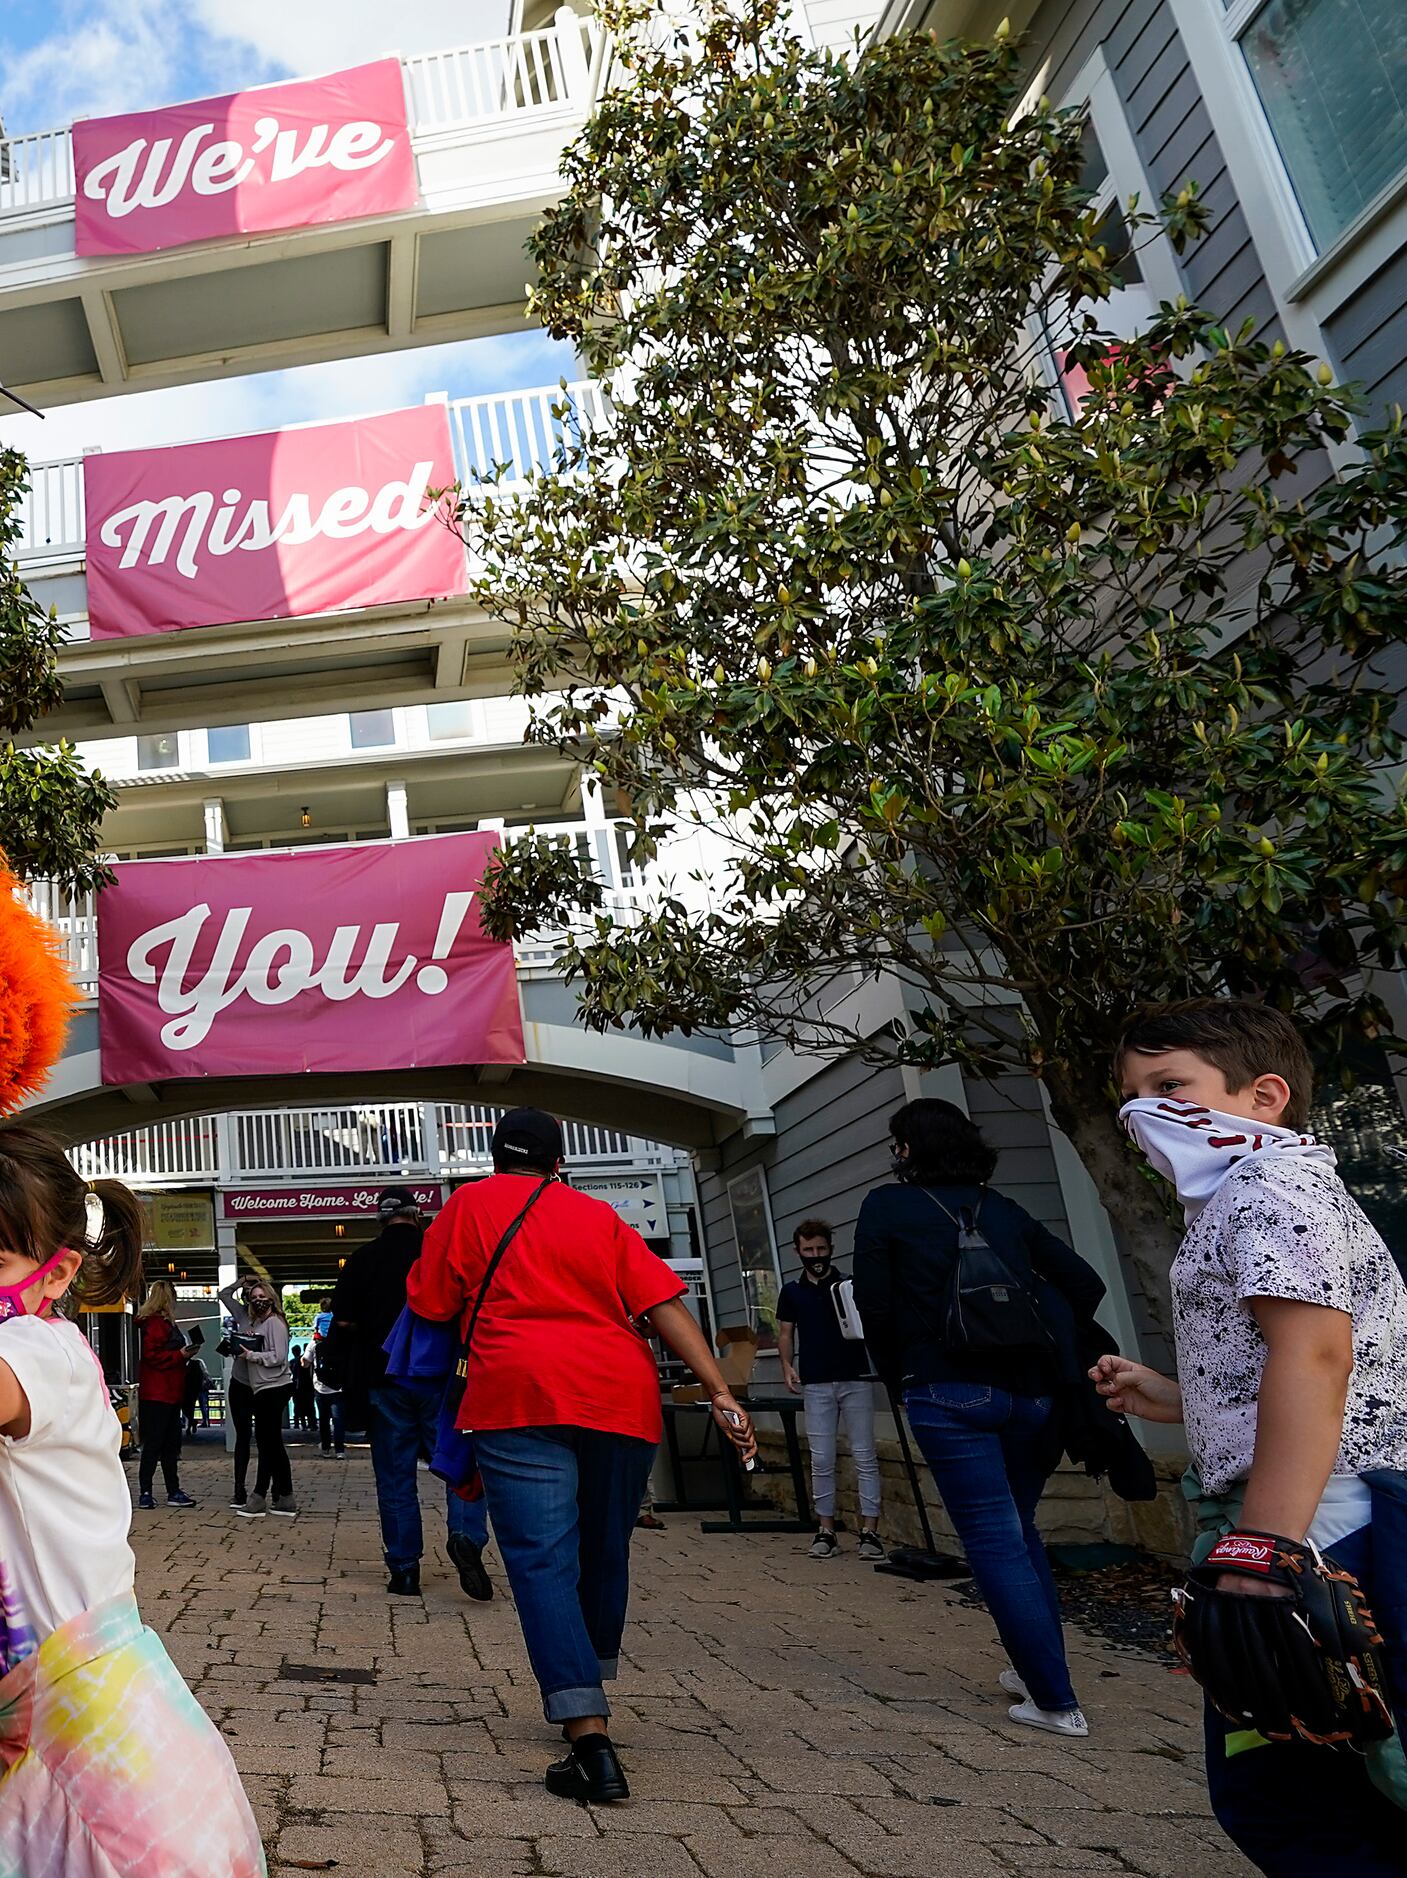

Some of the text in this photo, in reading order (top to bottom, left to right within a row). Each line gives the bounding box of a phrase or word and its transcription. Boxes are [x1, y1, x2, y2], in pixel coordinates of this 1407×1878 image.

[85, 117, 394, 218] We've
[100, 460, 442, 580] Missed
[127, 890, 476, 1051] You!
[230, 1195, 298, 1210] Welcome
[299, 1193, 350, 1210] Home.
[609, 1181, 640, 1190] 115-126
[1215, 1541, 1269, 1560] Rawlings
